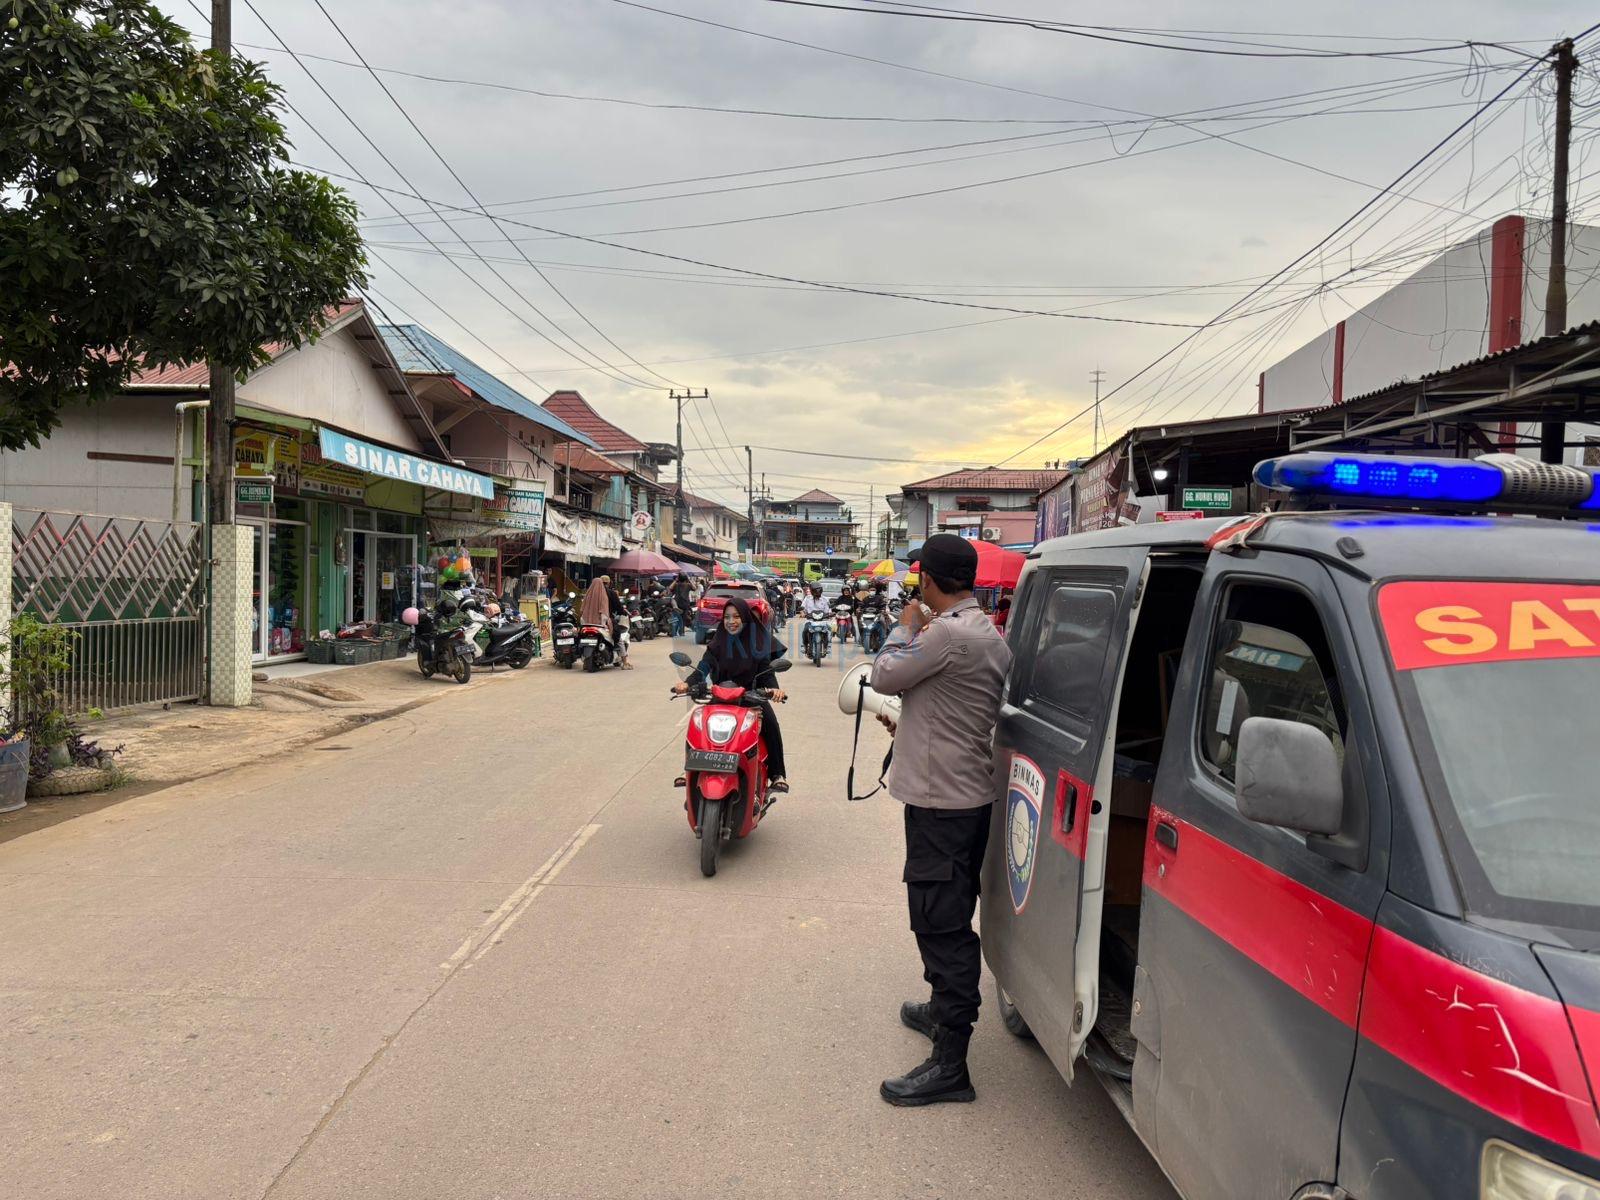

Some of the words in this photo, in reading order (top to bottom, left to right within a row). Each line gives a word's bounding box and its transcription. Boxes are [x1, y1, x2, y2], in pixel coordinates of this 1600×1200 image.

[235, 449, 264, 464] CAHAYA
[344, 442, 412, 480] SINAR
[417, 463, 483, 495] CAHAYA
[509, 496, 542, 516] CAHAYA
[1013, 763, 1040, 796] BINMAS
